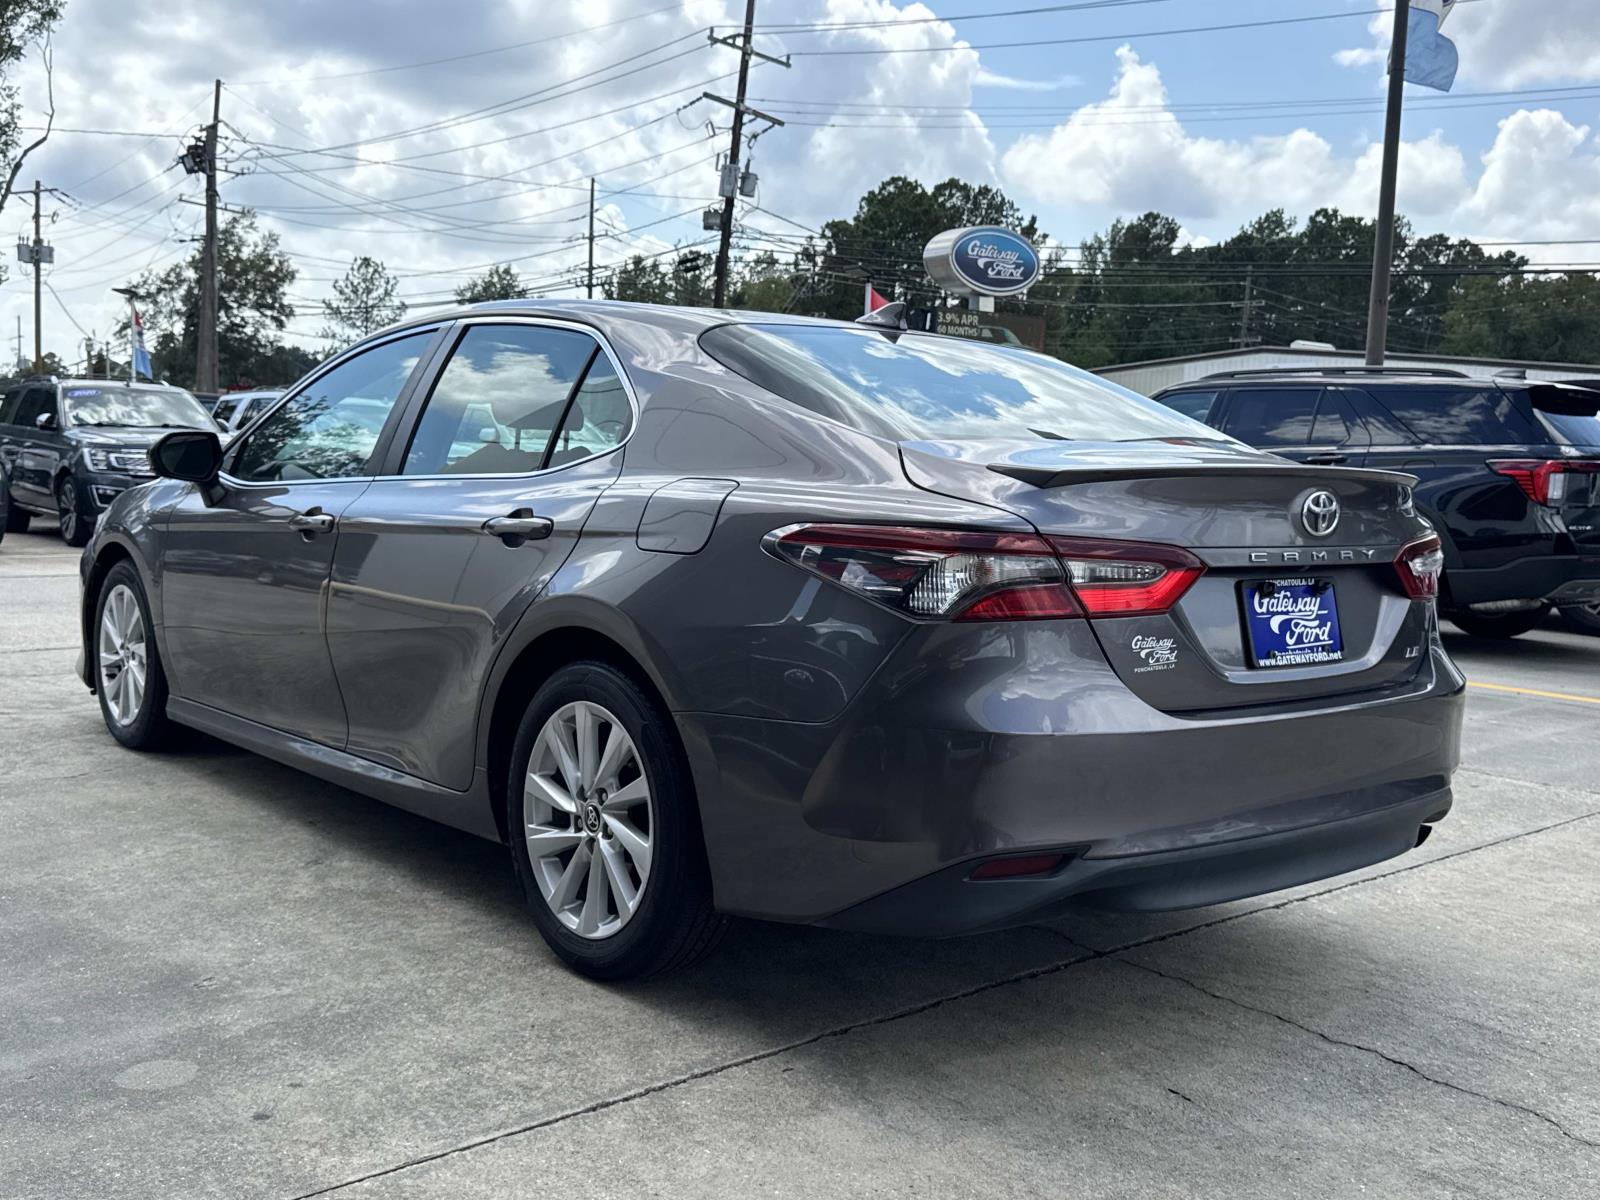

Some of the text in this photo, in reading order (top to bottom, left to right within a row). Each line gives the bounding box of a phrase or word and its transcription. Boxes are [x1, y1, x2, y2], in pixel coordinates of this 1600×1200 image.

[967, 240, 1020, 262] Gateway
[987, 262, 1024, 276] Ford
[938, 312, 979, 326] 3.9% APR
[947, 326, 978, 337] MONTHS
[1251, 550, 1375, 562] CAMRY
[1254, 590, 1321, 618] Gateway
[1286, 619, 1331, 645] Ford
[1132, 635, 1173, 649] Gateway
[1149, 650, 1177, 663] Ford
[1259, 650, 1342, 667] www.GATEWAYFORD.net
[1405, 646, 1419, 658] LE
